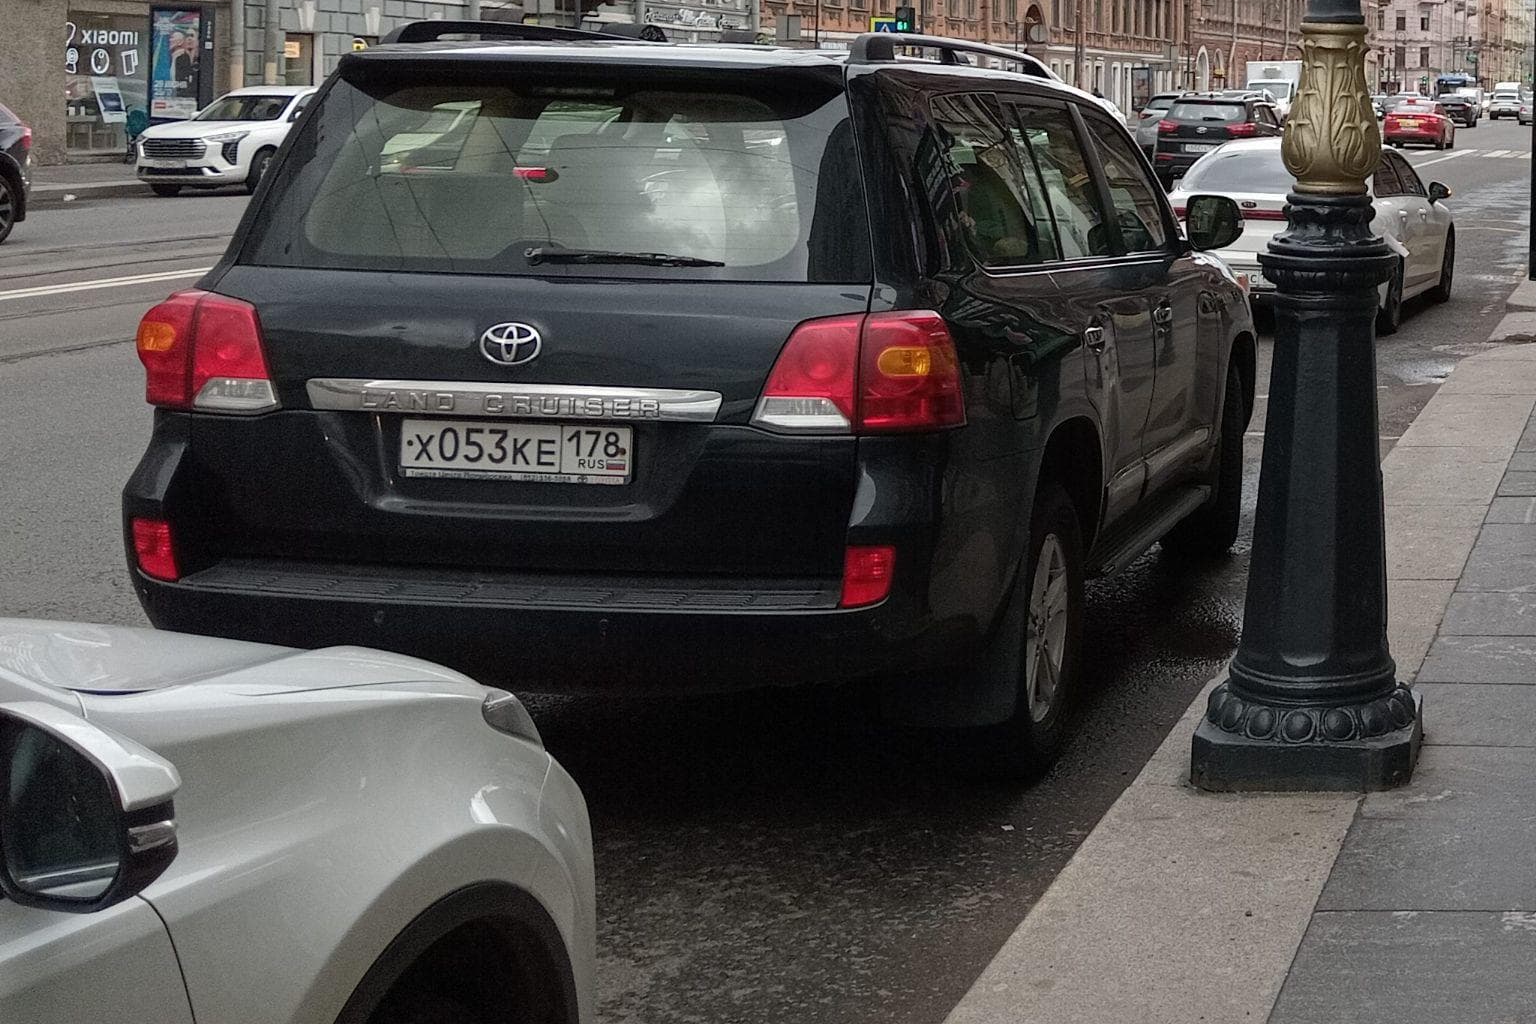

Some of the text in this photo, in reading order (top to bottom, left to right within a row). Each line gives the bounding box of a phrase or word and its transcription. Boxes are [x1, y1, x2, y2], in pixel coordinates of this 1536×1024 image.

[361, 390, 660, 418] LAND CRUISER
[567, 430, 621, 458] 178
[578, 458, 605, 470] RUS
